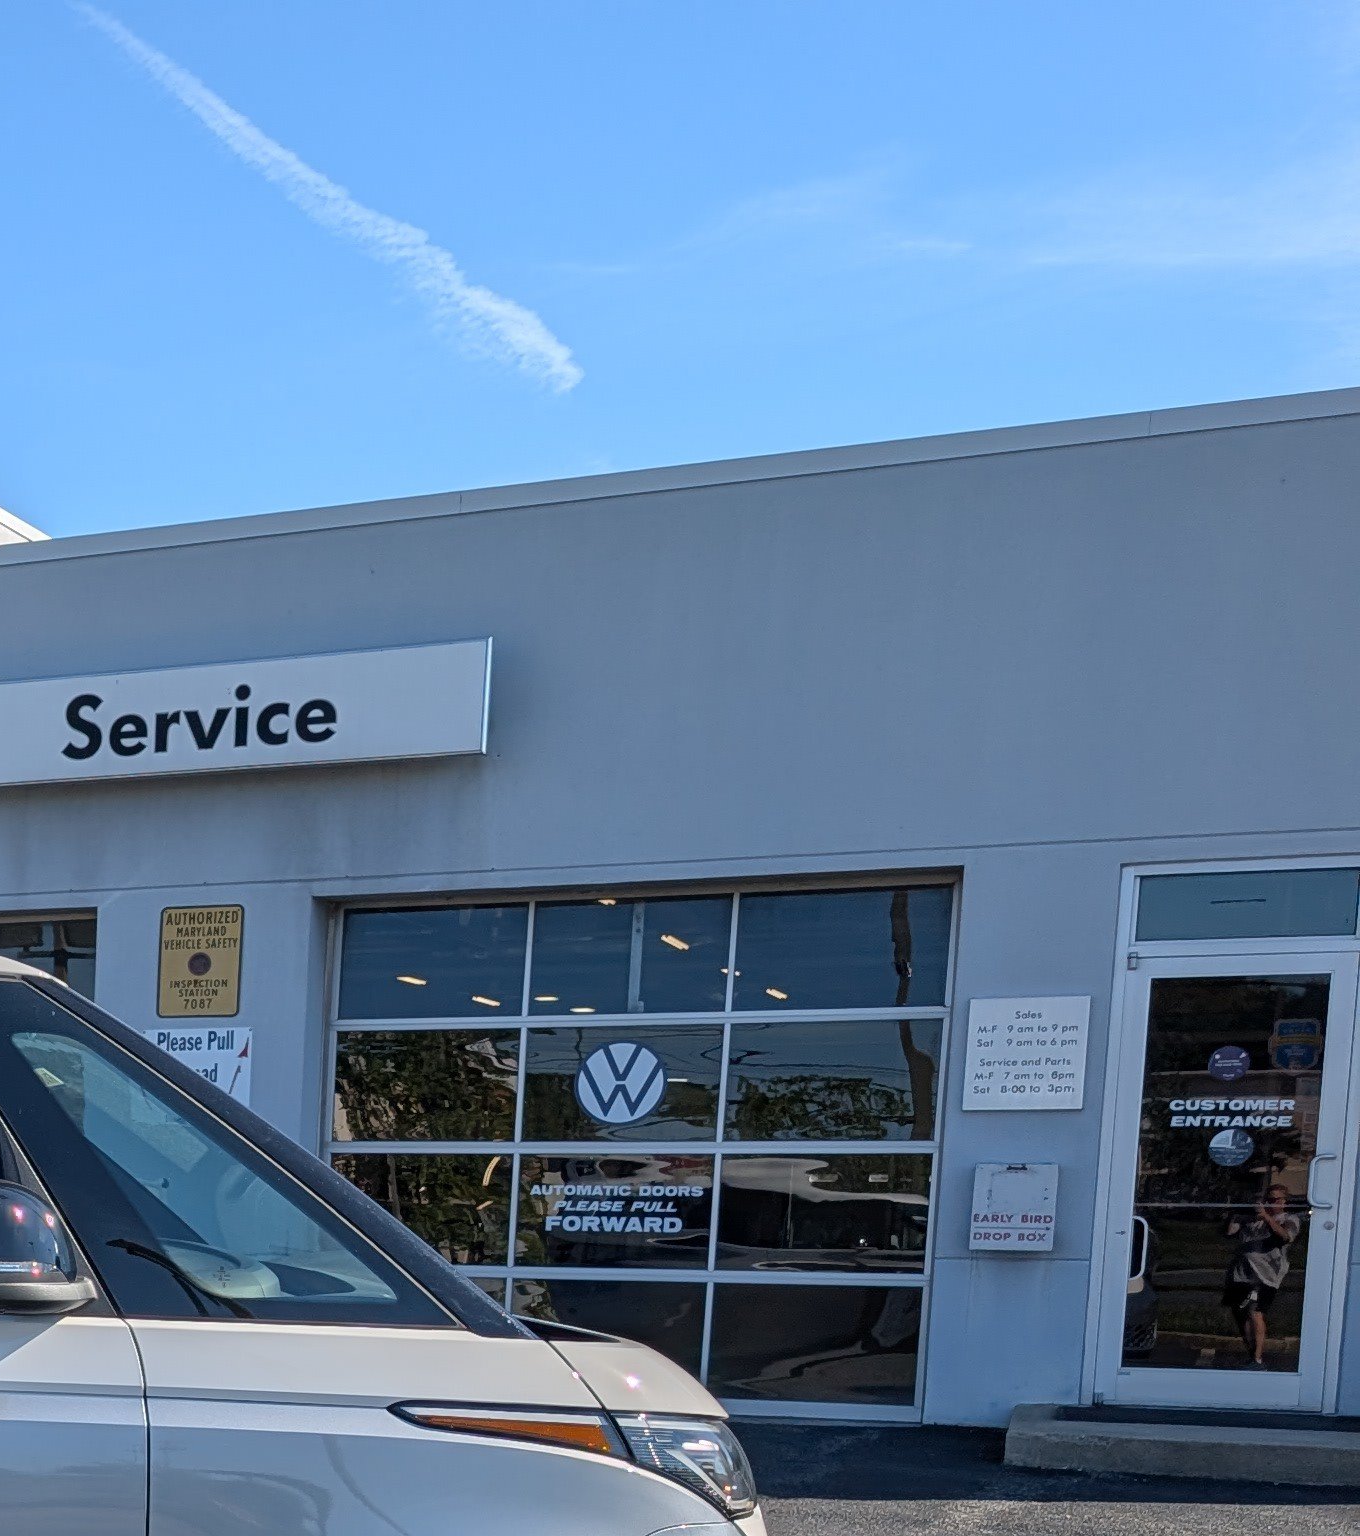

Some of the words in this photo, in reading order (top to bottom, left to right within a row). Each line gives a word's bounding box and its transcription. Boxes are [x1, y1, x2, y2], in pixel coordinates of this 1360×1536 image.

[61, 684, 337, 760] Service
[166, 911, 239, 926] AUTHORIZED
[176, 926, 226, 937] MARYLAND
[164, 939, 201, 950] VEHICLE
[205, 938, 238, 949] SAFETY
[170, 979, 228, 989] INSPECTION
[178, 989, 218, 997] STATION
[183, 999, 212, 1010] 7087
[1015, 1010, 1042, 1020] Sales
[977, 1025, 997, 1034] M-F
[1007, 1025, 1014, 1033] 9
[1037, 1025, 1047, 1033] to
[1052, 1024, 1058, 1032] 9
[1061, 1025, 1078, 1034] pm
[157, 1031, 202, 1051] Please
[207, 1030, 234, 1050] Pull
[977, 1039, 994, 1047] Sat
[1006, 1039, 1013, 1047] 9
[1050, 1038, 1057, 1046] 6
[1061, 1039, 1077, 1047] pm
[979, 1059, 1017, 1067] Service
[1021, 1058, 1041, 1066] and
[1044, 1058, 1071, 1066] Parts
[974, 1072, 994, 1080] M-F
[1004, 1072, 1010, 1080] 7
[1034, 1072, 1044, 1080] to
[973, 1086, 990, 1094] Sat
[1169, 1099, 1295, 1111] CUSTOMER
[1170, 1115, 1293, 1127] ENTRANCE
[530, 1185, 631, 1196] AUTOMATIC
[639, 1185, 704, 1197] DOORS
[553, 1201, 625, 1211] PLEASE
[630, 1201, 677, 1212] PULL
[973, 1214, 1014, 1223] EARLY
[1021, 1214, 1053, 1223] BIRD
[545, 1216, 683, 1233] FORWARD
[973, 1232, 1011, 1241] DROP
[1017, 1232, 1046, 1241] BOX
